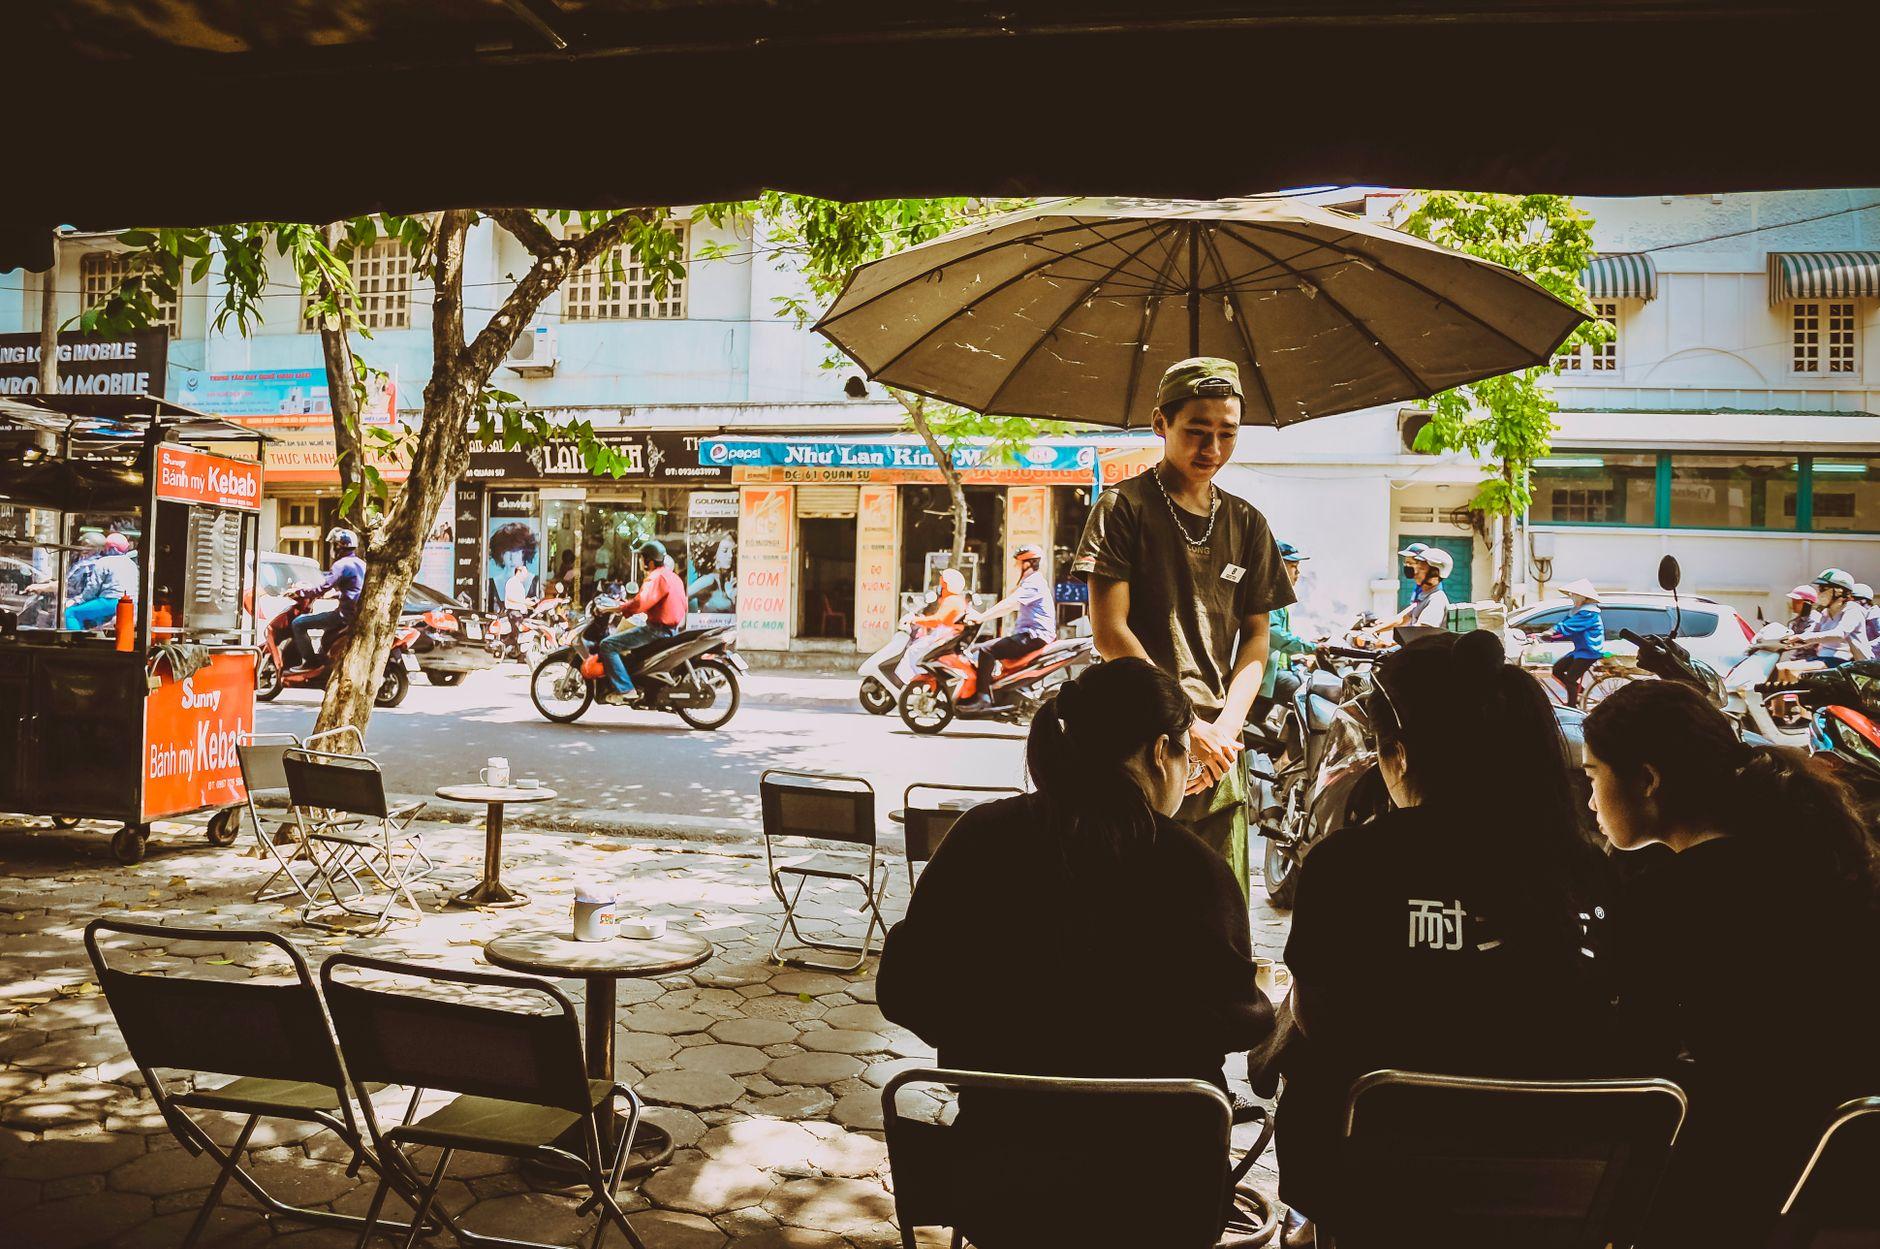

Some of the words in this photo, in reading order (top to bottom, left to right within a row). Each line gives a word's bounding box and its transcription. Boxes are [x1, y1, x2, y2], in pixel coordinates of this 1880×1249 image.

[27, 344, 72, 362] LOG
[73, 342, 137, 361] MOBILE
[75, 372, 149, 395] MOBILE
[729, 447, 761, 460] pepsi
[784, 446, 834, 465] Như
[840, 446, 884, 465] Lan
[162, 467, 189, 488] Bánh
[207, 465, 257, 498] Kebab
[805, 470, 818, 479] 61
[458, 491, 476, 501] TIGI
[181, 677, 221, 712] Sunny
[150, 742, 177, 779] Bánh
